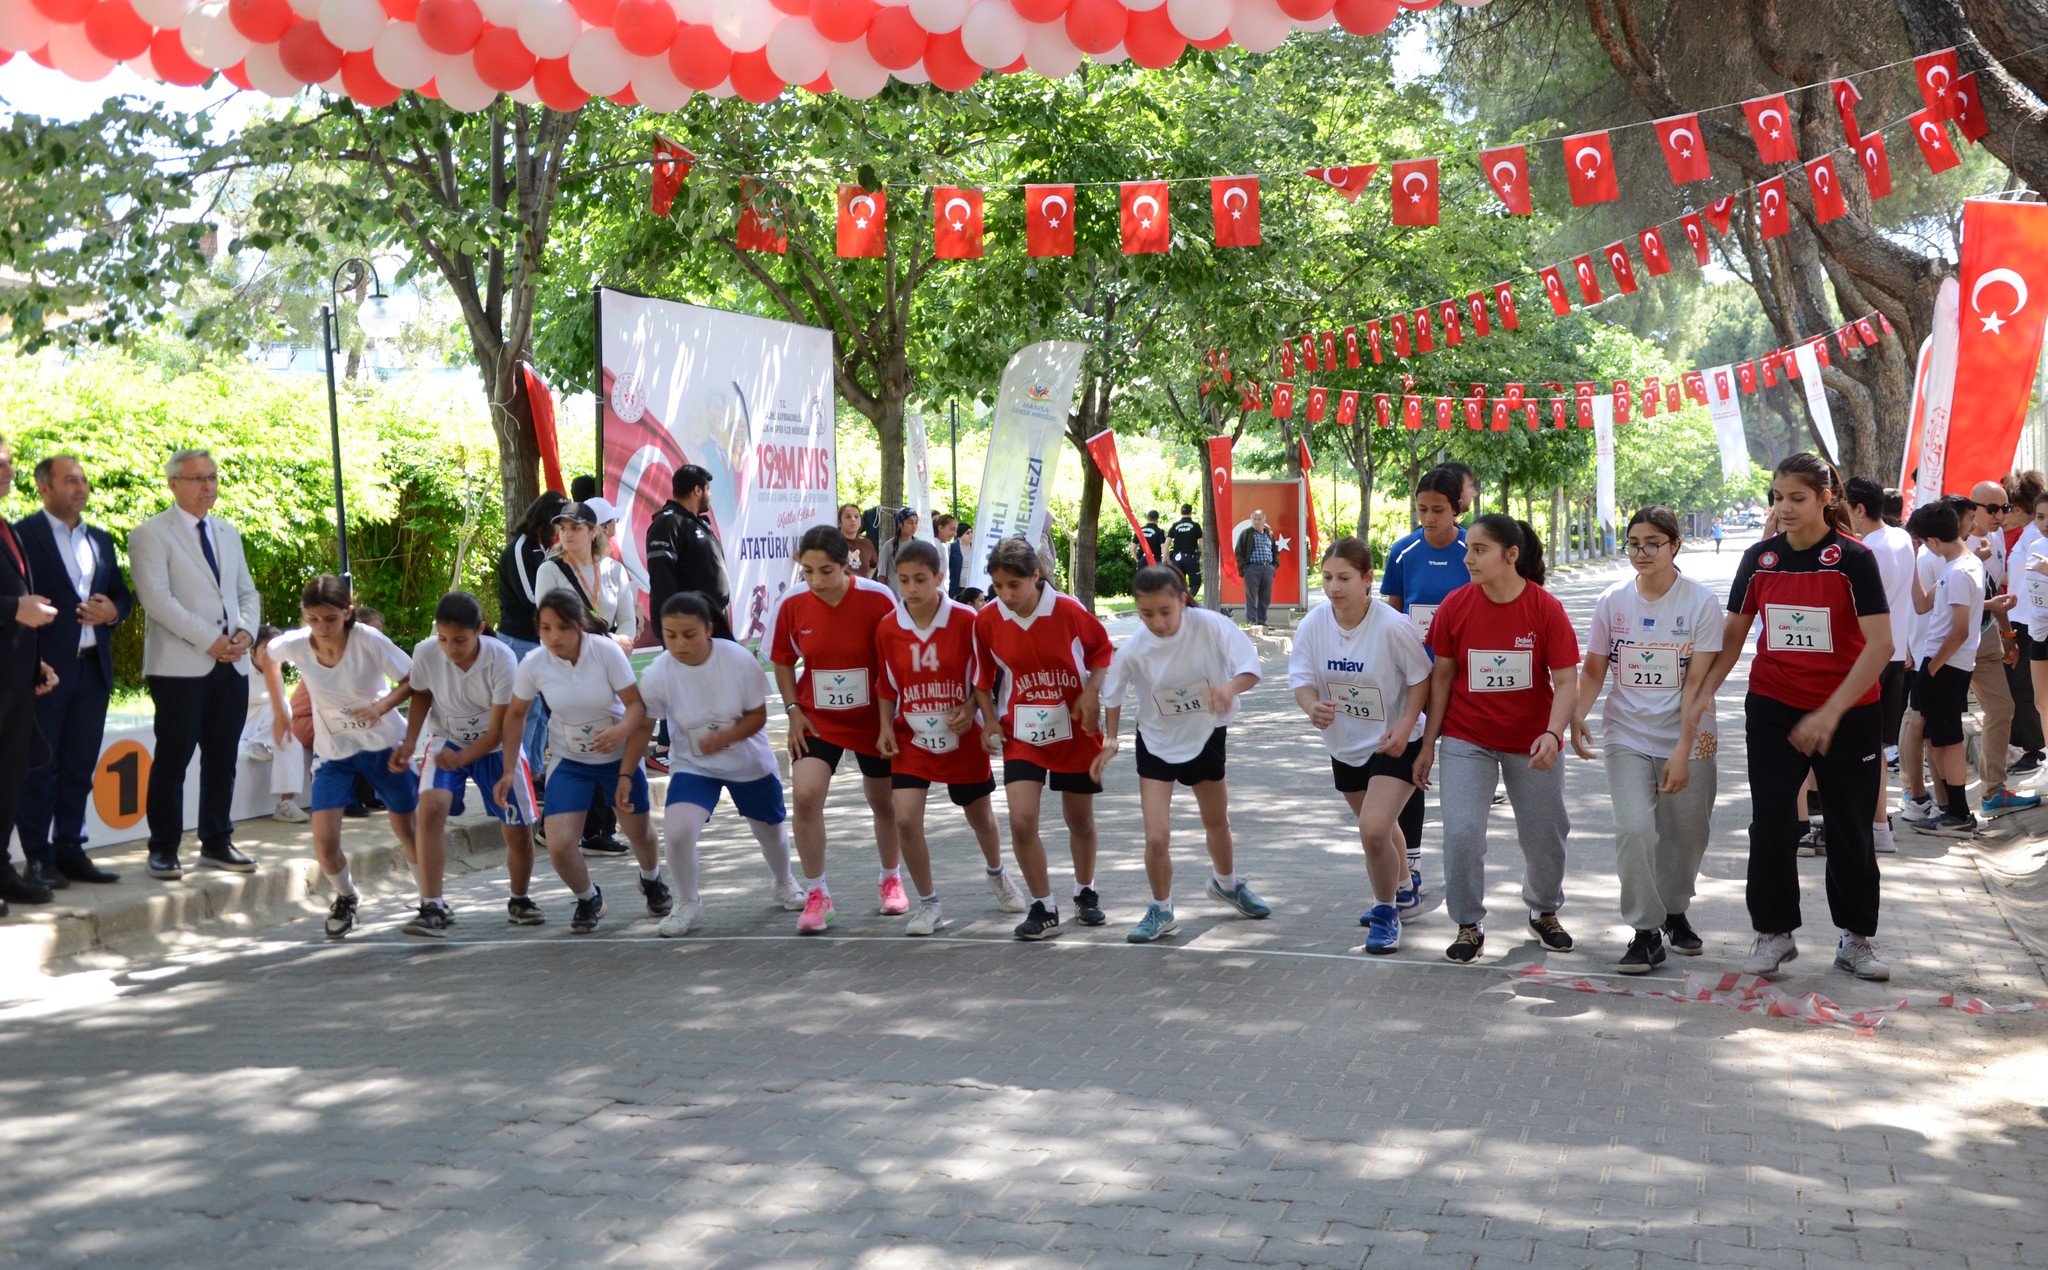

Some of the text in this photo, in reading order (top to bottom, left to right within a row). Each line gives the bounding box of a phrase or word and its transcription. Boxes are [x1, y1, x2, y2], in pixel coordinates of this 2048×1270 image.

[781, 445, 829, 490] MAYIS
[740, 531, 789, 560] ATATÜRK
[1784, 633, 1815, 648] 211
[909, 642, 940, 673] 14
[1327, 657, 1365, 673] miav
[1486, 675, 1515, 688] 213
[1634, 672, 1663, 686] 212
[828, 692, 854, 705] 216
[1173, 699, 1201, 713] 218
[1344, 703, 1370, 718] 219
[341, 720, 367, 729] 220
[462, 730, 489, 741] 22
[1030, 727, 1057, 742] 214
[106, 751, 138, 817] 1
